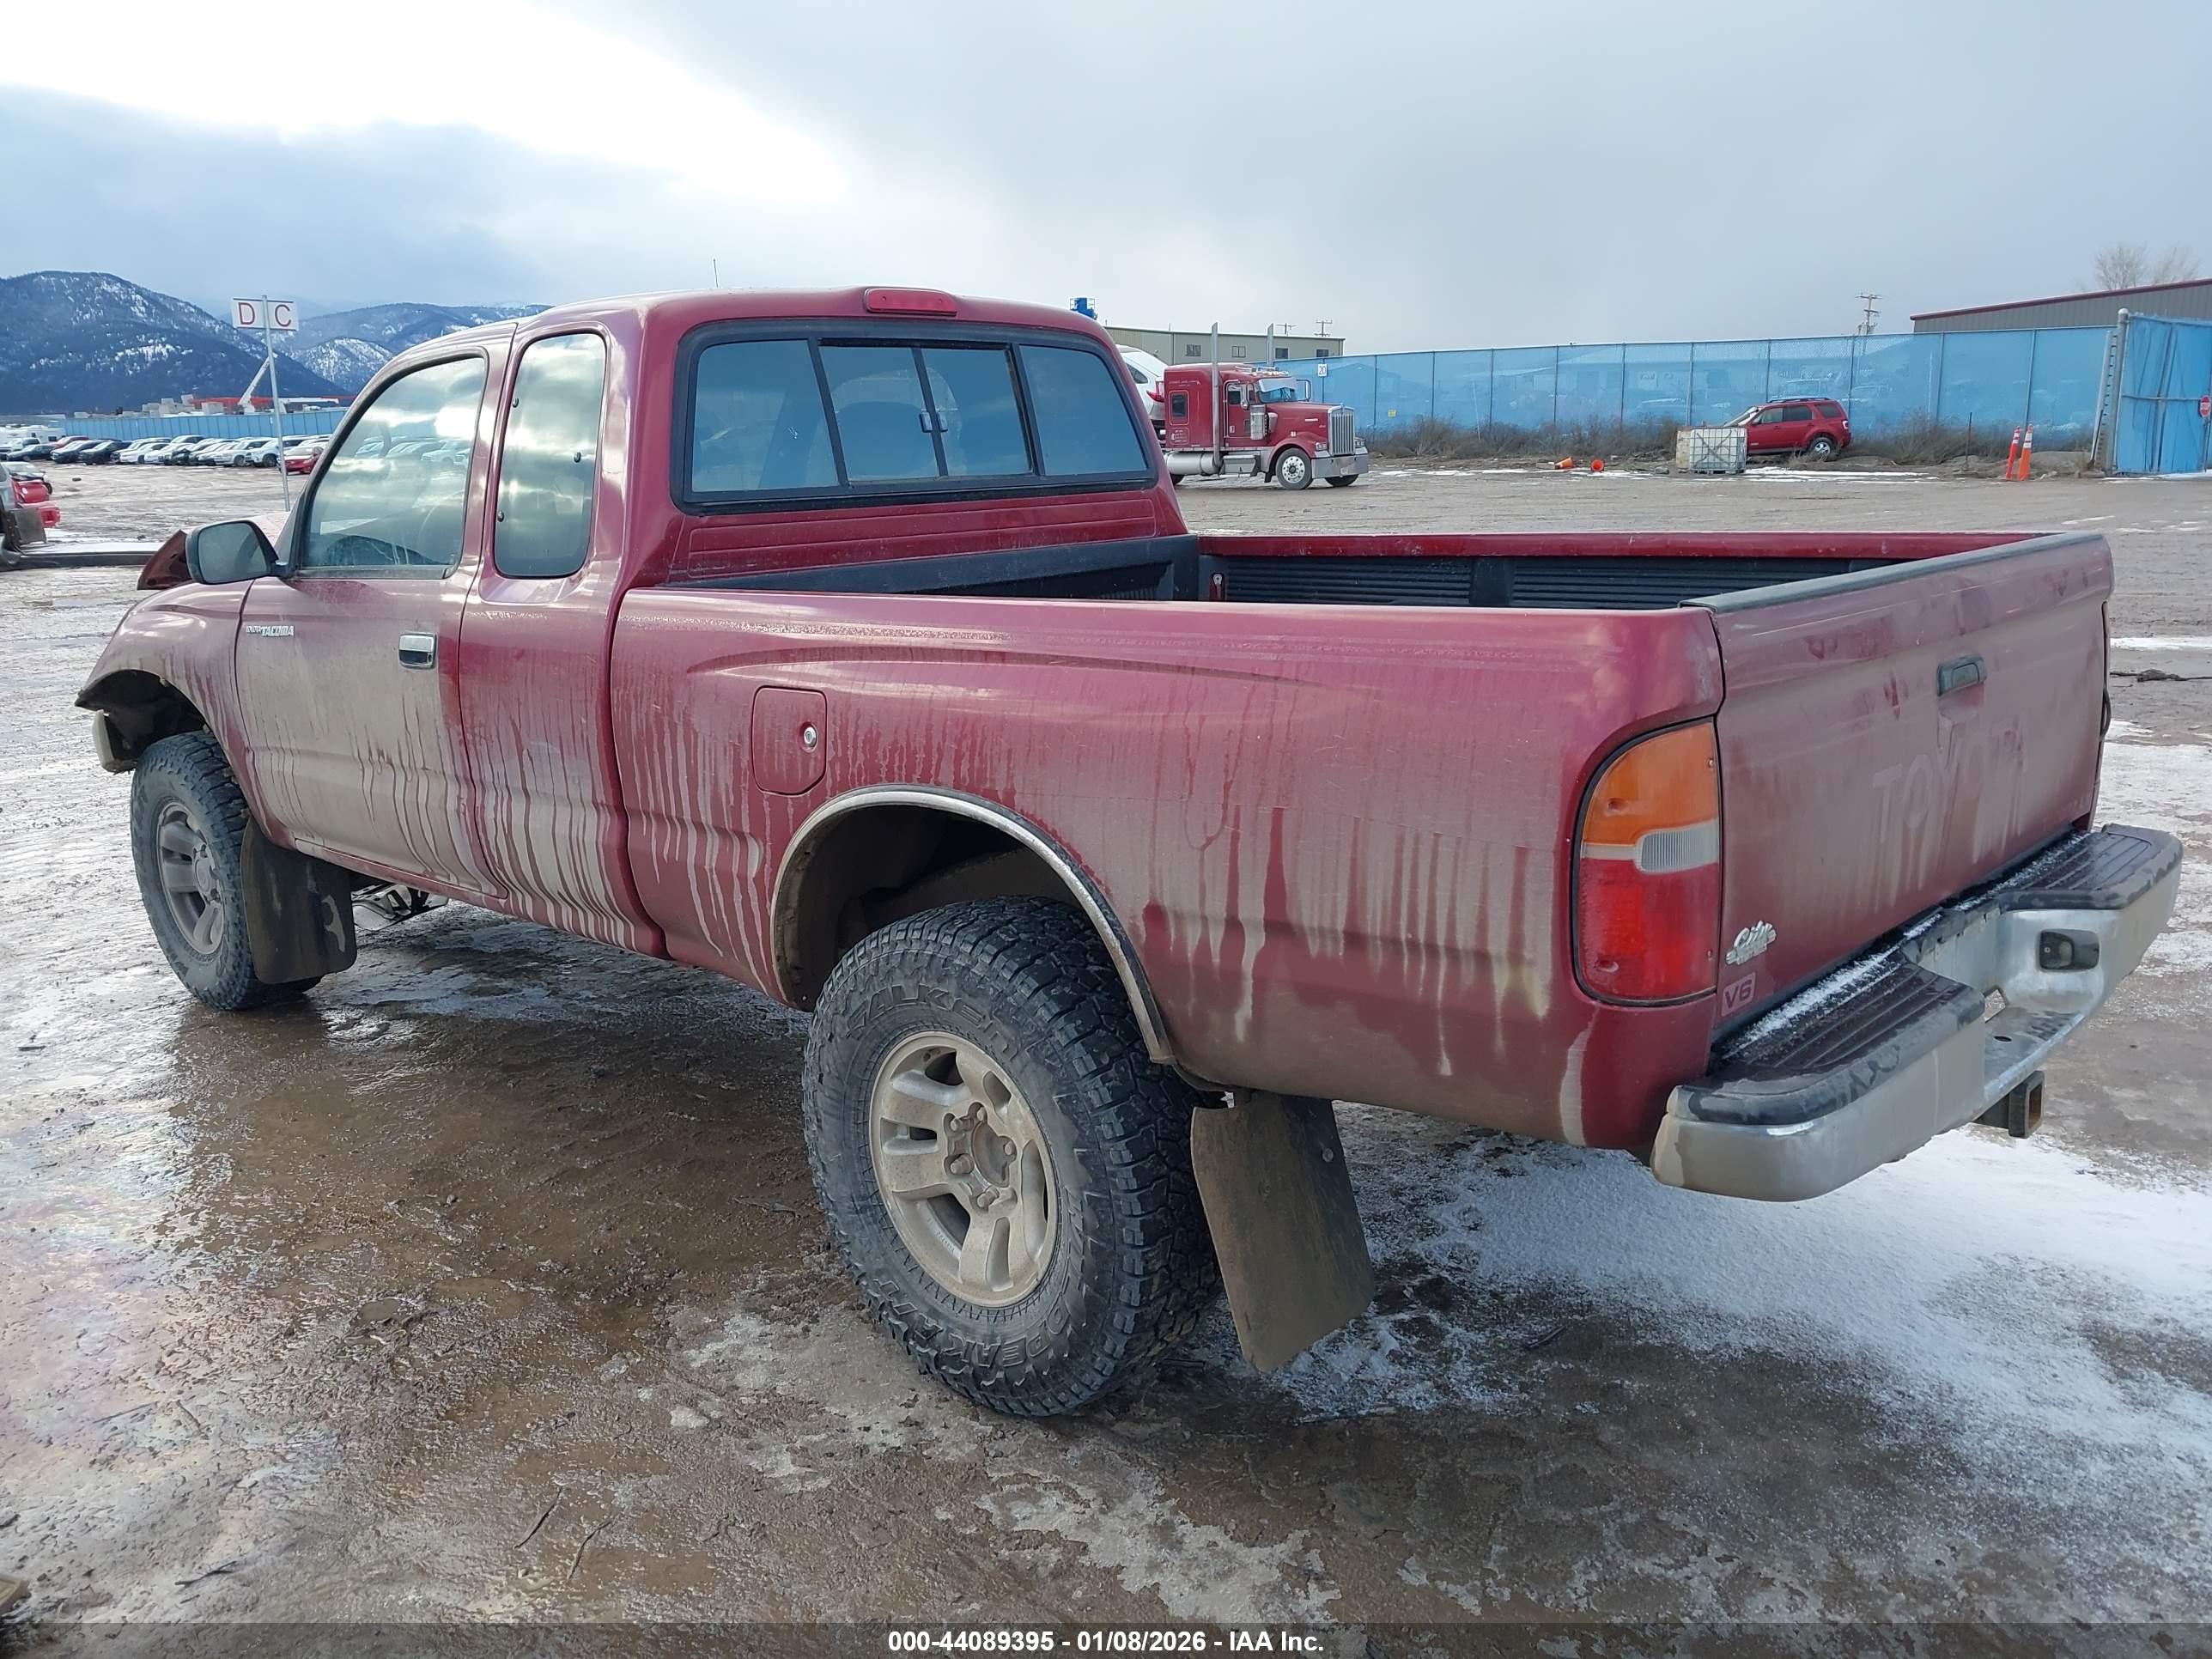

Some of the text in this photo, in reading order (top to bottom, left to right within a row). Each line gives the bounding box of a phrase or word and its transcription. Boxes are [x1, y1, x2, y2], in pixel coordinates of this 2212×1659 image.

[238, 302, 292, 327] D C
[1318, 366, 1327, 375] 20
[1725, 979, 1752, 1008] V6
